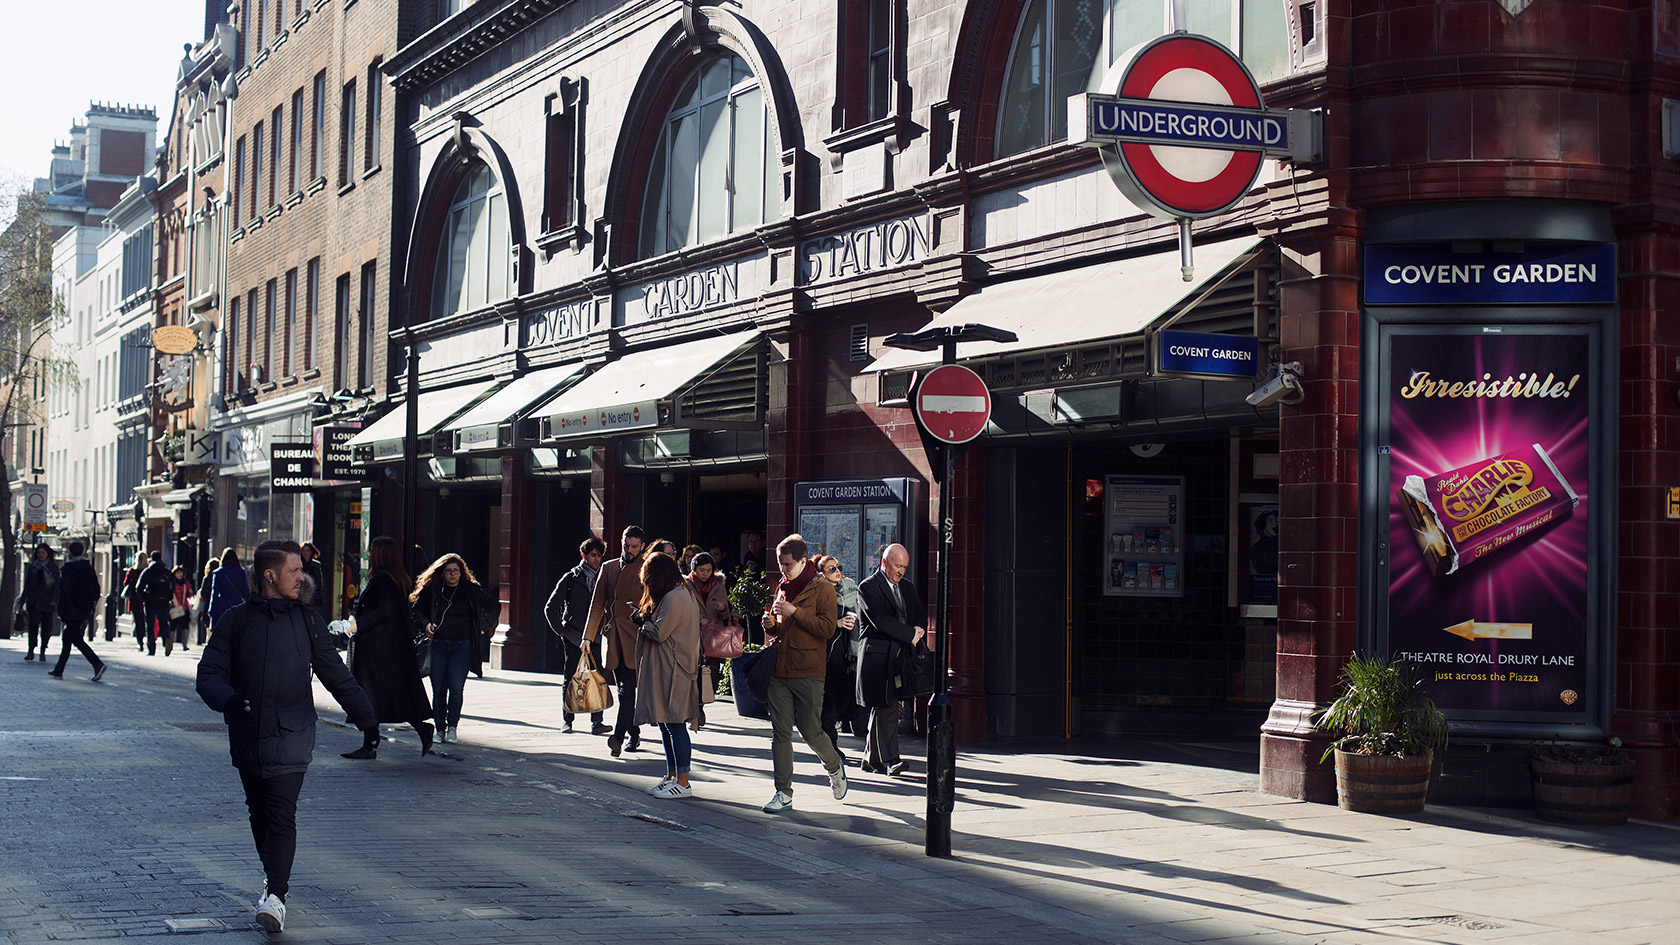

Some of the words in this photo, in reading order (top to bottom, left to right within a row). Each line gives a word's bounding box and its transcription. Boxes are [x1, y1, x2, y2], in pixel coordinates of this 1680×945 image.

[1099, 105, 1281, 144] UNDERGROUND
[524, 301, 594, 347] COVENT
[643, 262, 739, 318] GARDEN
[803, 215, 930, 282] STATION
[1384, 265, 1485, 284] COVENT
[1493, 264, 1597, 283] GARDEN
[1170, 345, 1209, 358] COVENT
[1212, 349, 1251, 361] GARDEN
[1400, 371, 1580, 399] Irresistible!
[566, 419, 572, 427] No
[608, 413, 617, 424] No
[618, 411, 632, 424] entry
[273, 450, 314, 459] BUREAU
[287, 463, 302, 472] DE
[808, 487, 834, 498] COVENT
[835, 486, 862, 498] GARDEN
[863, 485, 891, 497] STATION
[1446, 461, 1527, 516] CHARLIE
[1466, 503, 1516, 534] CHOCOLATE
[1514, 488, 1548, 510] FACTORY
[1456, 525, 1466, 534] AND
[1458, 530, 1468, 539] THE
[1474, 544, 1493, 558] The
[1493, 534, 1514, 546] New
[1514, 509, 1553, 536] Musical
[1400, 651, 1453, 663] THEATRE
[1456, 653, 1495, 664] ROYAL
[1498, 654, 1539, 665] DRURY
[1542, 655, 1575, 666] LANE
[1434, 671, 1453, 682] just
[1455, 673, 1487, 681] across
[1490, 671, 1506, 681] the
[1509, 672, 1539, 682] Piazza
